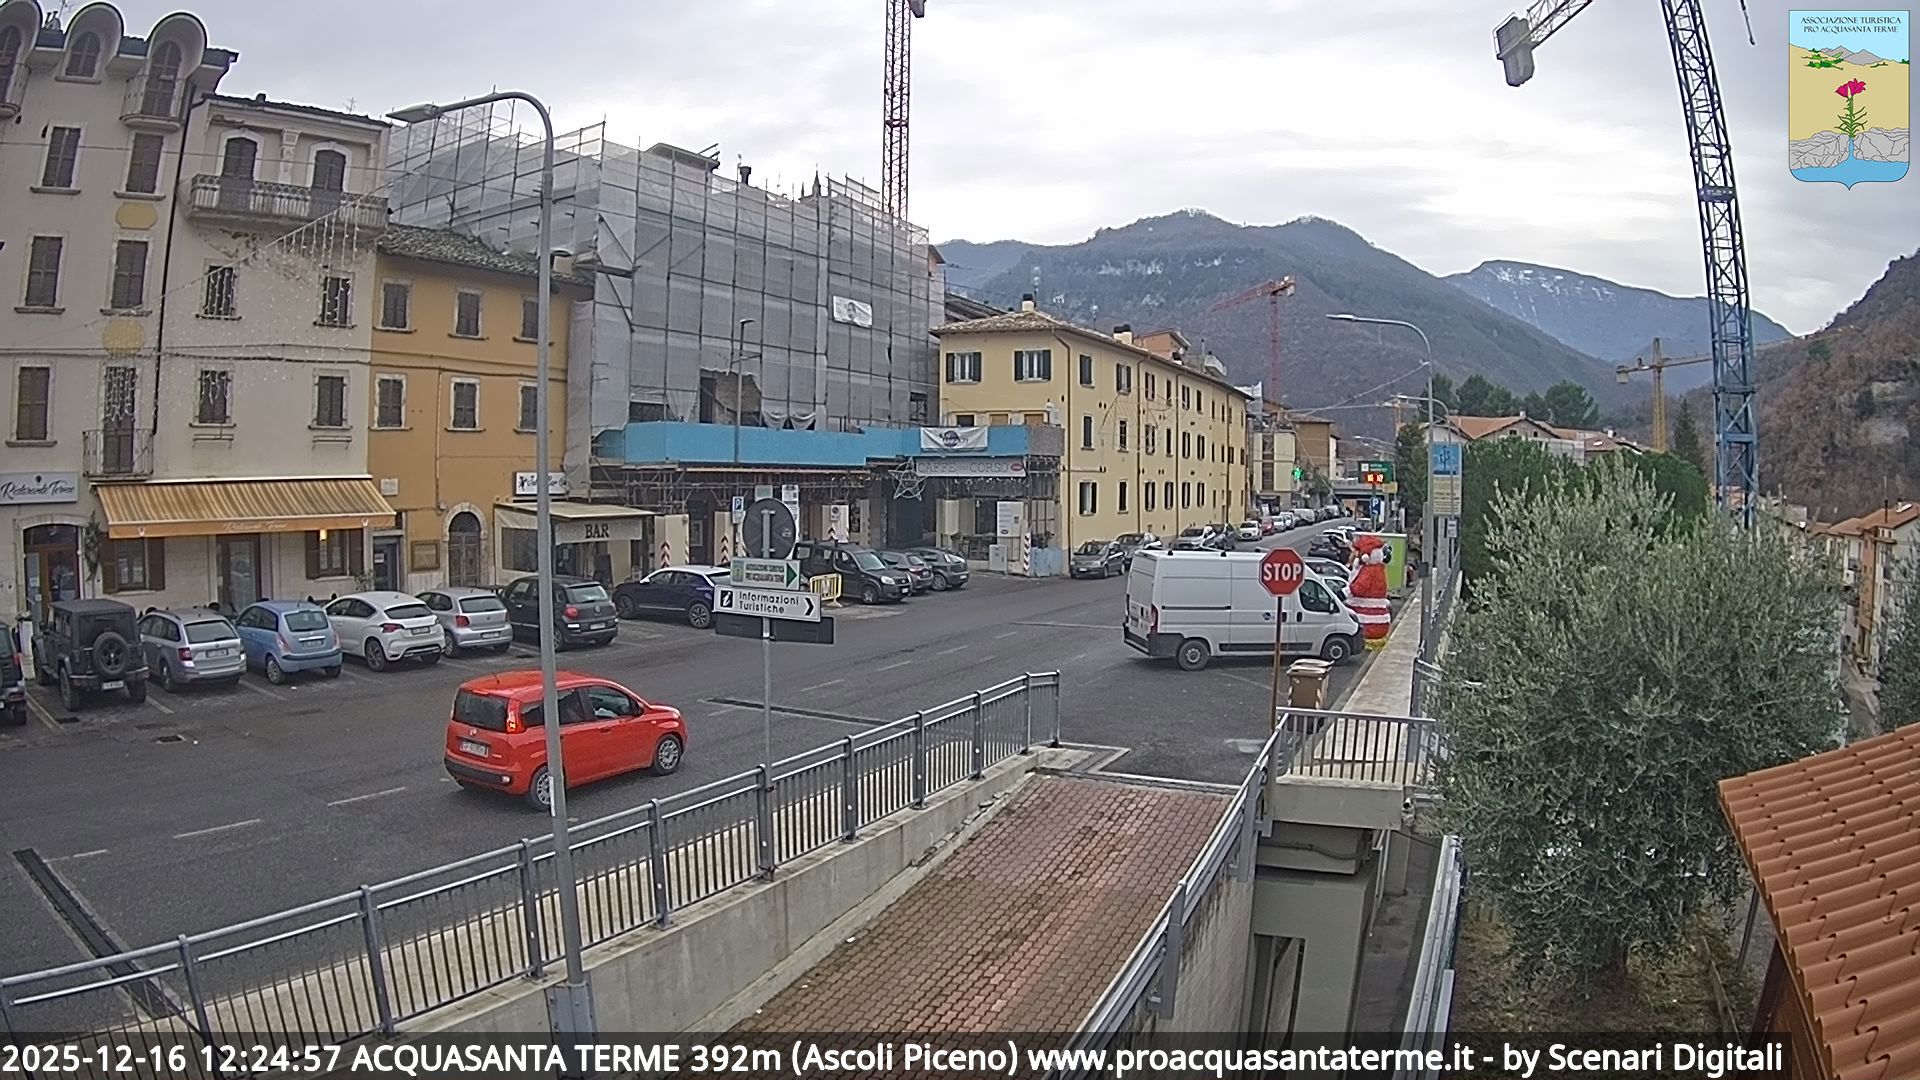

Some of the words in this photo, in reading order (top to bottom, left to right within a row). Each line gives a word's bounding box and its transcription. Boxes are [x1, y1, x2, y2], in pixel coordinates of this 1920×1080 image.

[585, 523, 609, 539] BAR
[1263, 562, 1302, 582] STOP
[739, 591, 799, 606] Informazioni
[739, 601, 785, 614] Turistiche
